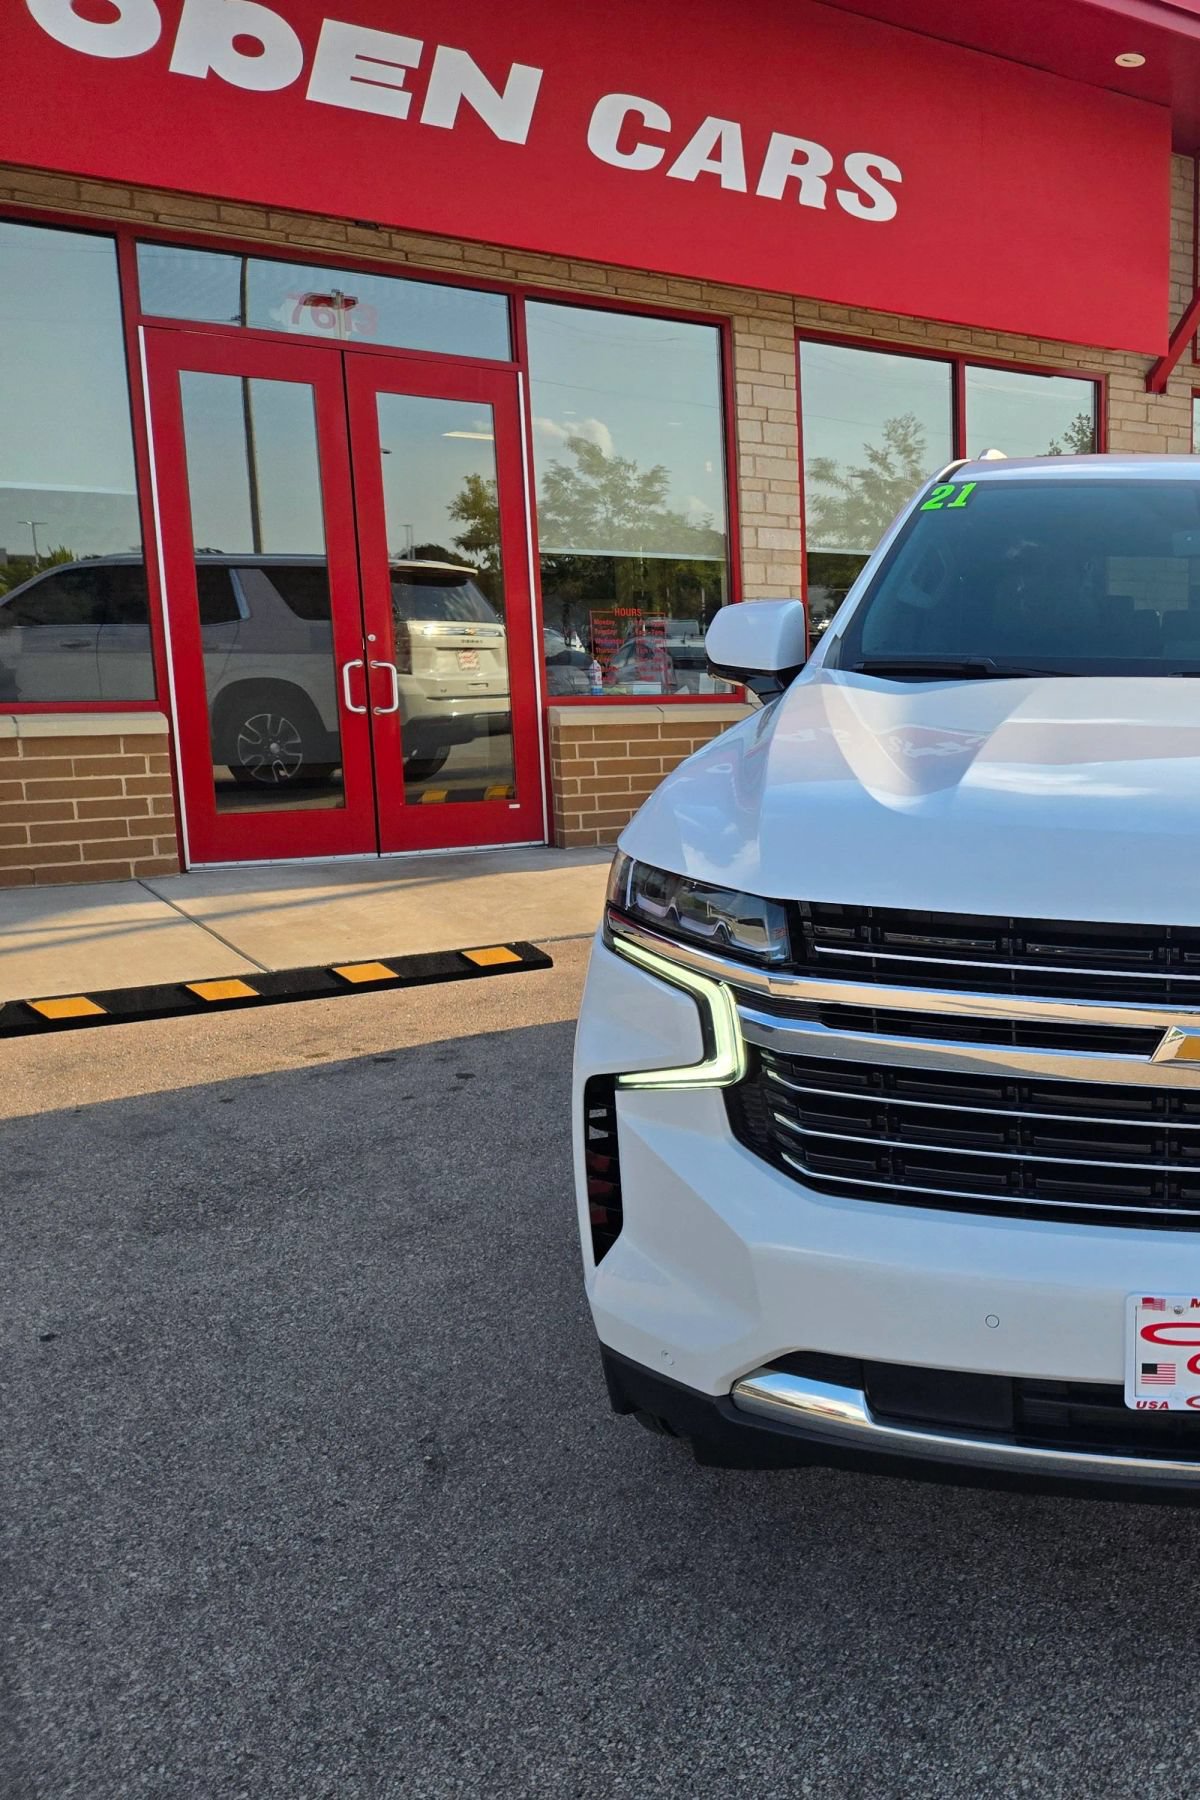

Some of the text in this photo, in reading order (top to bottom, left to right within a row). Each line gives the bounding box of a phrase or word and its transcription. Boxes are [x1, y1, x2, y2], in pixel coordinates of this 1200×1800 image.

[586, 93, 903, 222] CARS
[919, 482, 977, 511] 21
[614, 607, 642, 617] HOURS
[1135, 1401, 1170, 1411] USA
